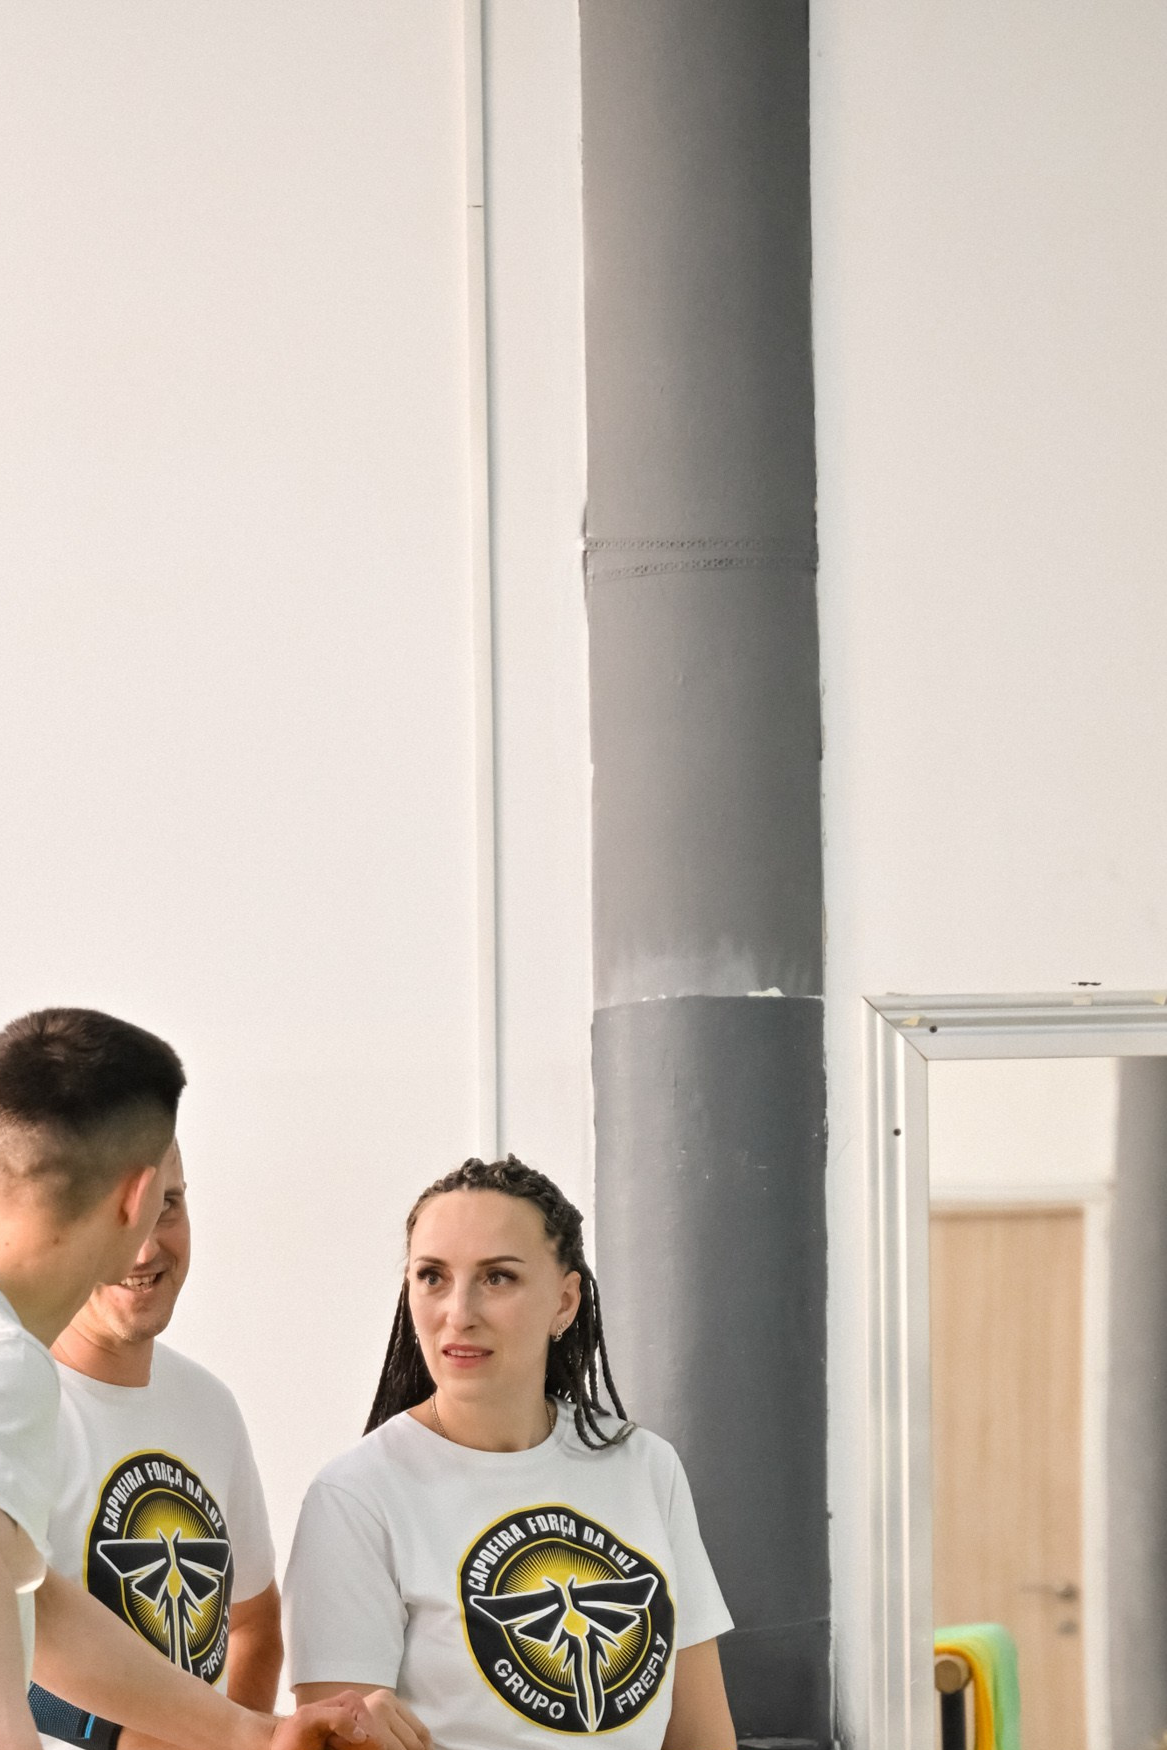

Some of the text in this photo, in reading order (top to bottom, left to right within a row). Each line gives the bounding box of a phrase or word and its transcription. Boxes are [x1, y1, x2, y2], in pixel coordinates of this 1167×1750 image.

[102, 1461, 224, 1533] CAPOEIRA FORÇA DA LUZ
[468, 1513, 639, 1592] CAPOEIRA FORÇA DA LUZ
[200, 1604, 230, 1680] FIREFLY
[494, 1633, 668, 1720] GRUPO FIREFLY
